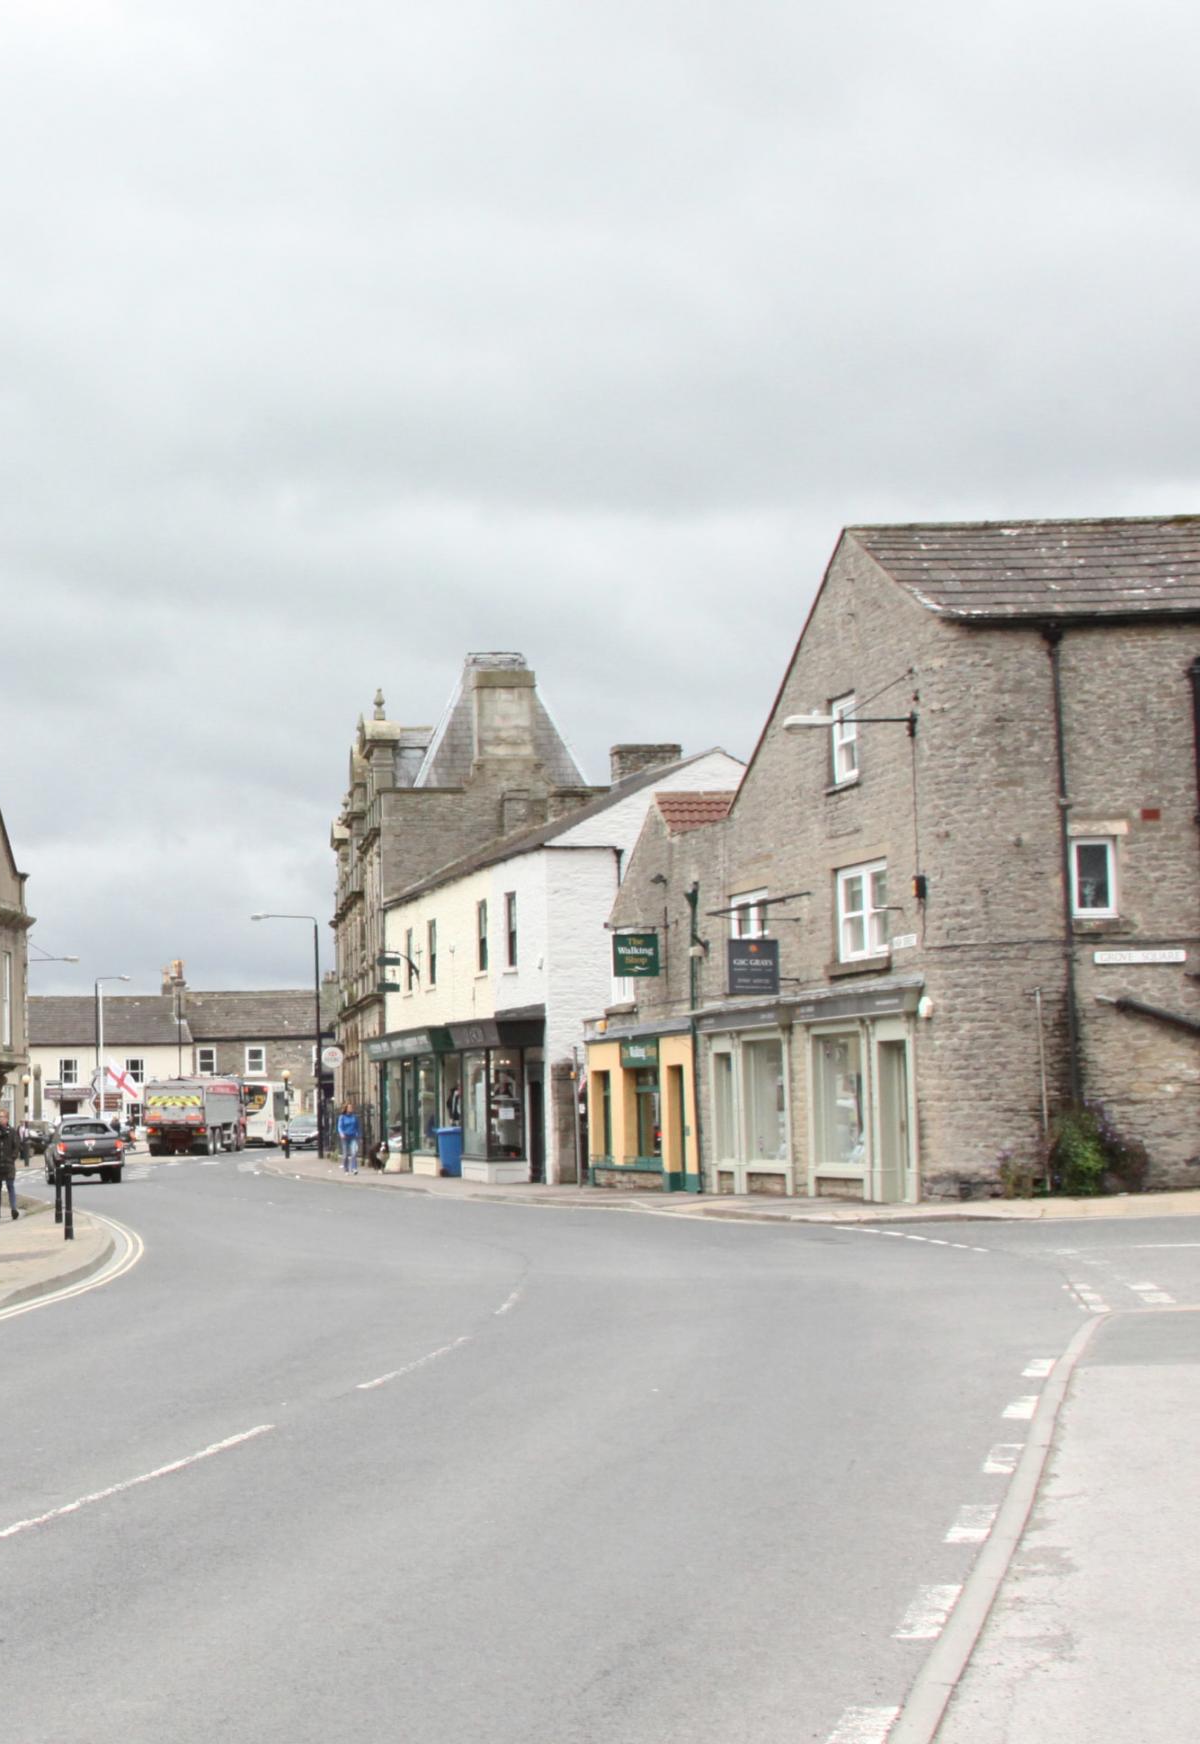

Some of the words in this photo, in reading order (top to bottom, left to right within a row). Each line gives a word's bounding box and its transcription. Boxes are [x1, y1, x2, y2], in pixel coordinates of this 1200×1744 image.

[617, 946, 654, 956] Walking
[1101, 952, 1137, 961] GROVE
[1142, 951, 1180, 960] SQUARE
[624, 956, 648, 965] Shop
